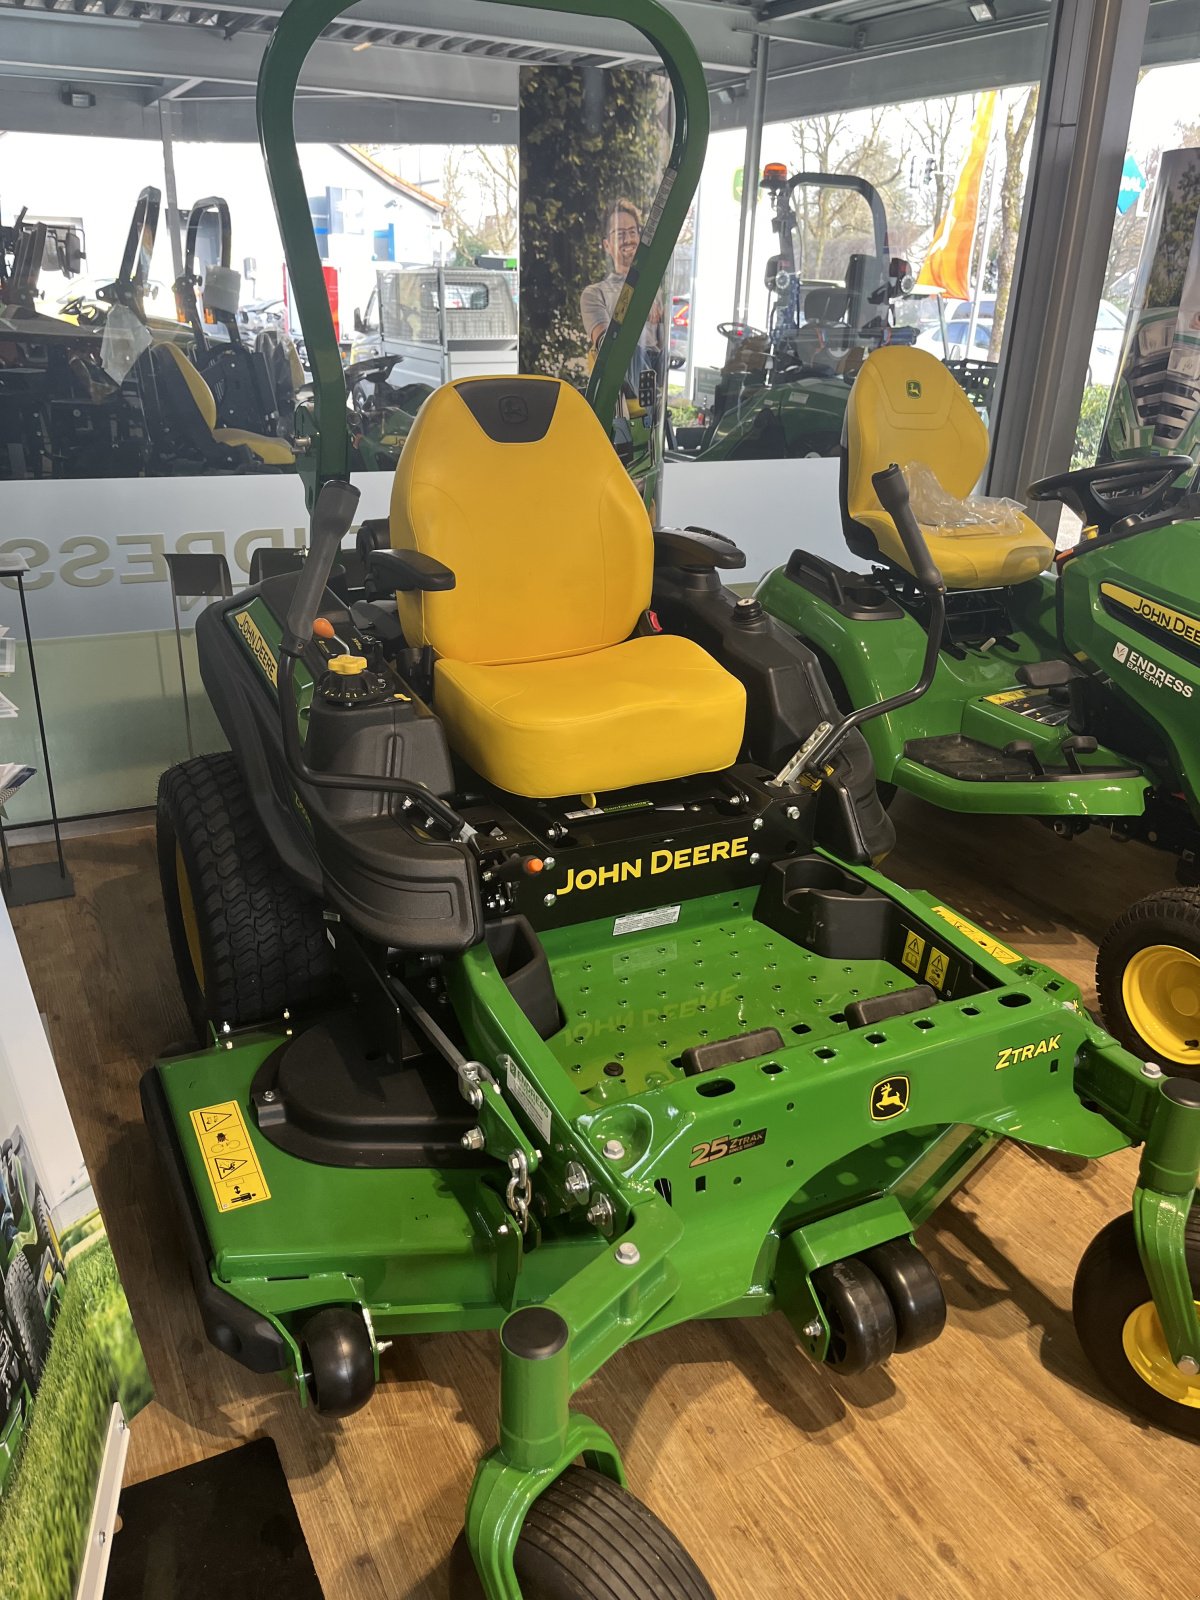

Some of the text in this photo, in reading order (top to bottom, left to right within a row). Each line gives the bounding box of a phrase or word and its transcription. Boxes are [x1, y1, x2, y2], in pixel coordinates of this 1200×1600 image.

[1133, 599, 1171, 628] JOHN
[239, 615, 275, 679] JOHN DEERE
[1126, 661, 1164, 688] BAYERN
[1128, 651, 1193, 698] ENDRESS
[556, 836, 749, 896] JOHN DEERE
[994, 1032, 1063, 1071] ZTRAK
[689, 1135, 730, 1168] 25
